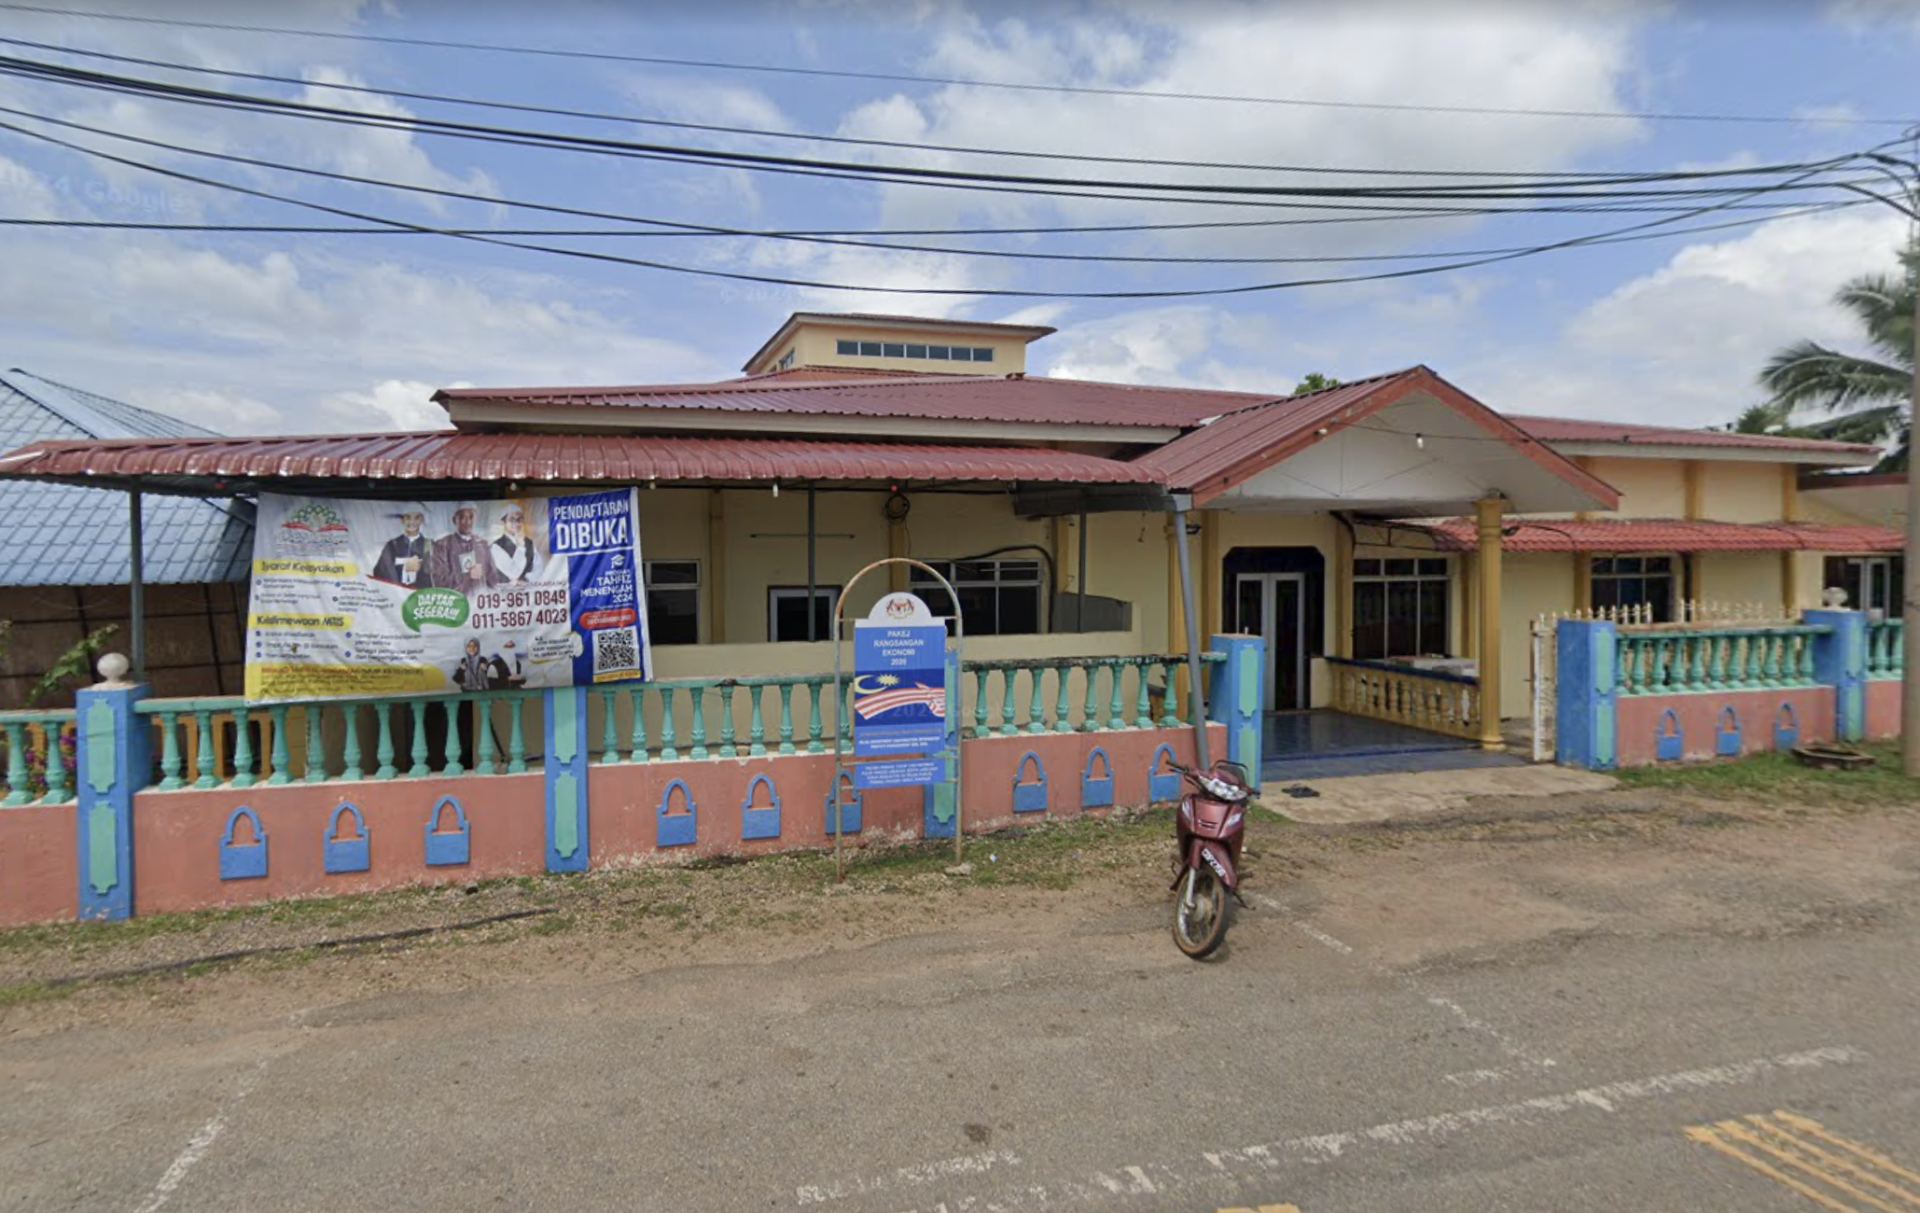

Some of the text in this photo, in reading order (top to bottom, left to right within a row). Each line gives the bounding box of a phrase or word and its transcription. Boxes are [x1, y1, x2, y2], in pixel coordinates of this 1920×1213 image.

[554, 499, 629, 520] PENDAFTARAN
[556, 517, 628, 550] DIBUKA
[597, 574, 632, 587] TAHFIZ
[580, 584, 633, 598] MENENGAH
[476, 589, 567, 610] 019-961 0849
[613, 593, 634, 604] 2024
[472, 611, 533, 629] 011-5867
[536, 608, 568, 625] 4023
[887, 630, 911, 638] PAKEJ
[874, 638, 924, 648] RANGSANGAN
[881, 648, 915, 657] EKONOMI
